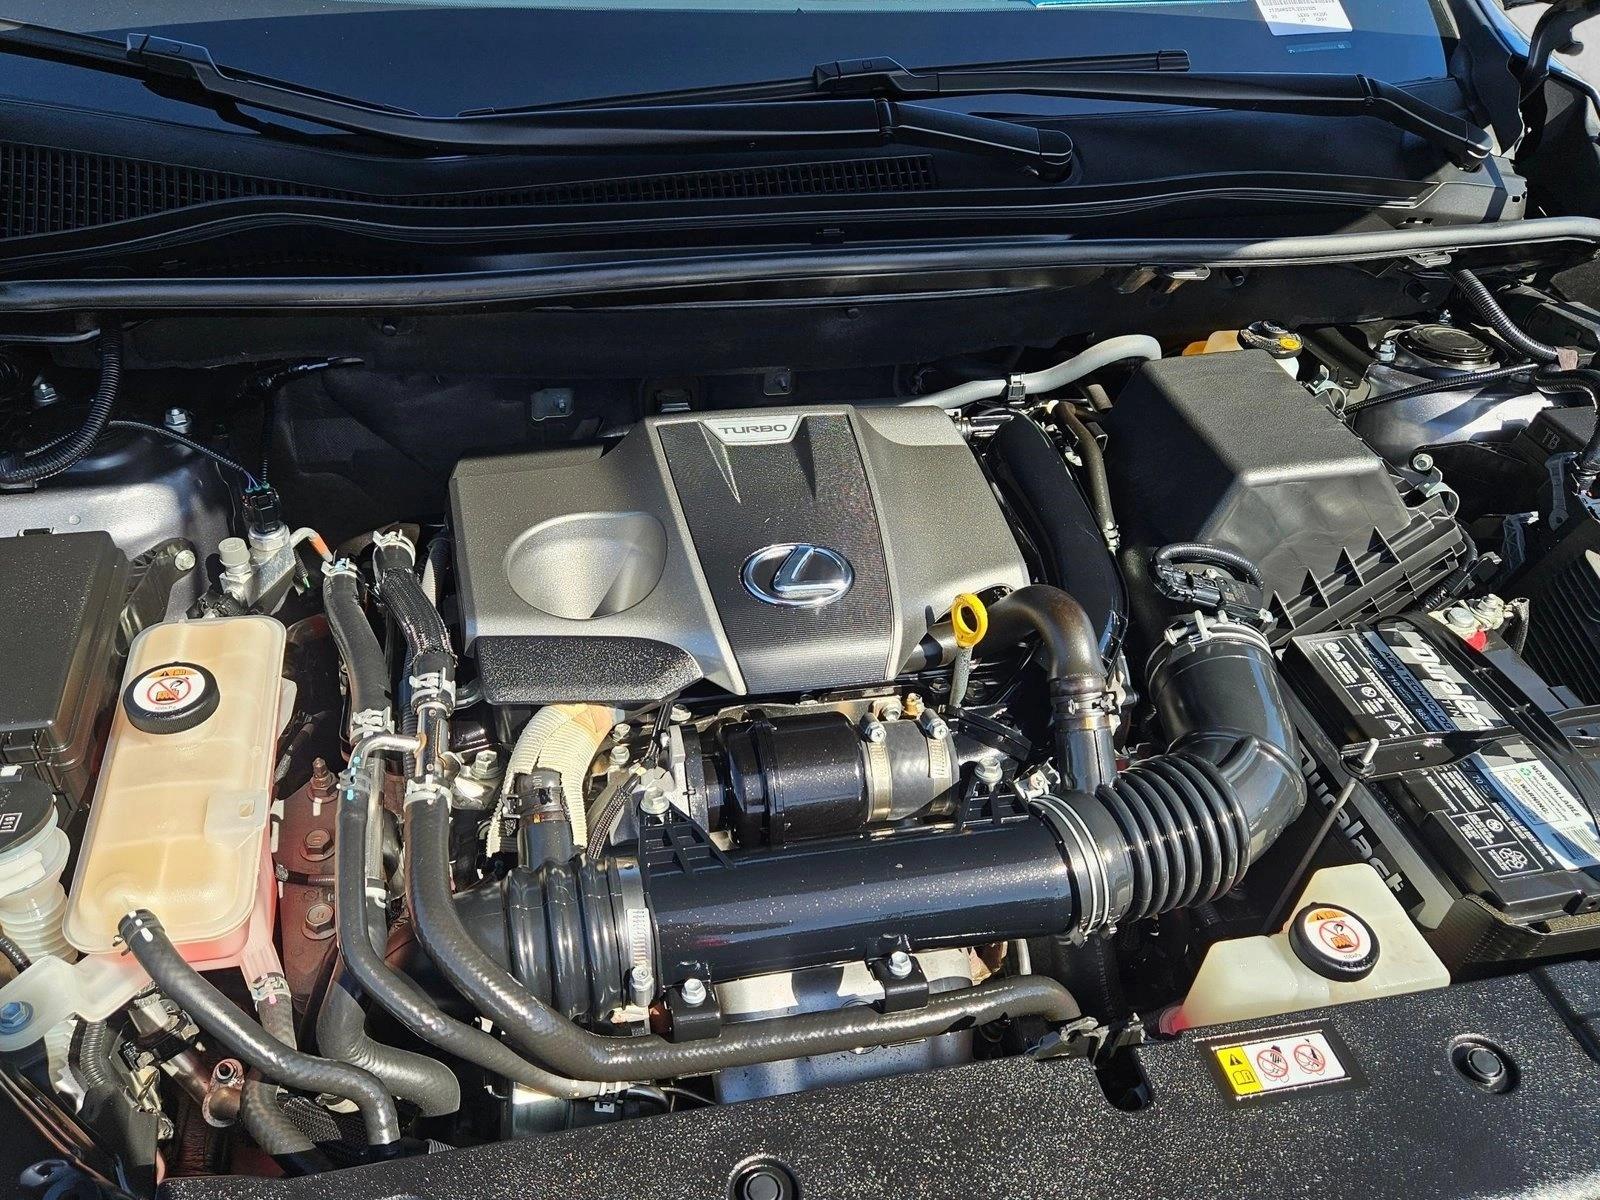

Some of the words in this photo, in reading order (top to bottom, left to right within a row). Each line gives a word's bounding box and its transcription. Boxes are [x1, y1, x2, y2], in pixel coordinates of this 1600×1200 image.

[718, 424, 788, 435] TURBO
[1542, 426, 1561, 450] TB
[1381, 650, 1404, 671] AGM
[1402, 673, 1455, 731] TECHNOLOG
[1472, 774, 1484, 785] 70
[1531, 764, 1582, 818] NON-SPILLABLE
[1520, 783, 1550, 815] WARNING:
